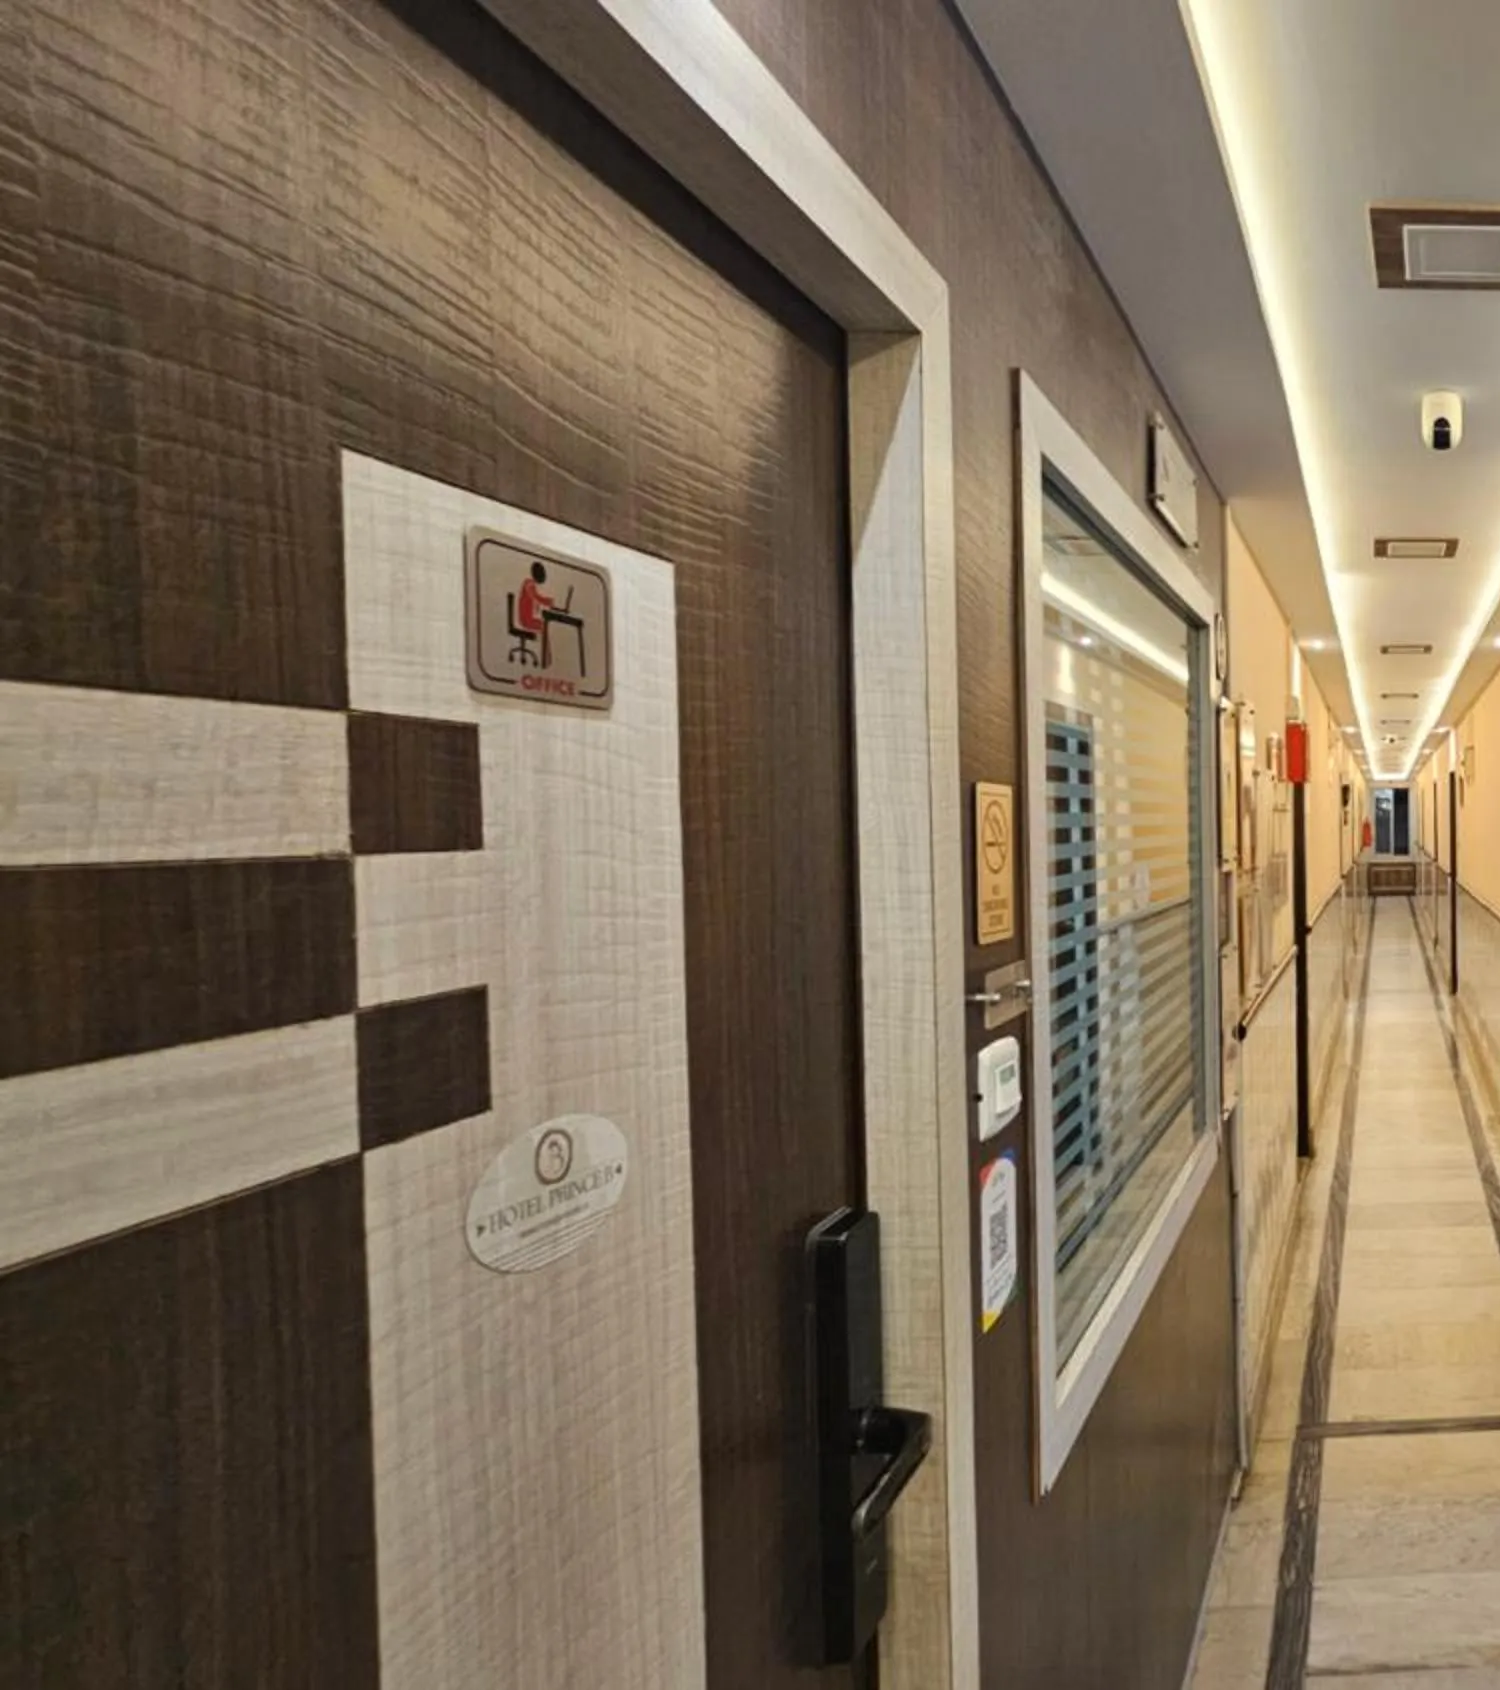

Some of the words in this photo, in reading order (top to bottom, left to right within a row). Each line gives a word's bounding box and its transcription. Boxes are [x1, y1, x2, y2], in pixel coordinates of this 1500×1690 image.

[521, 675, 575, 696] OFFICE
[489, 1195, 545, 1234] HOTEL
[549, 1170, 602, 1208] PRINCE
